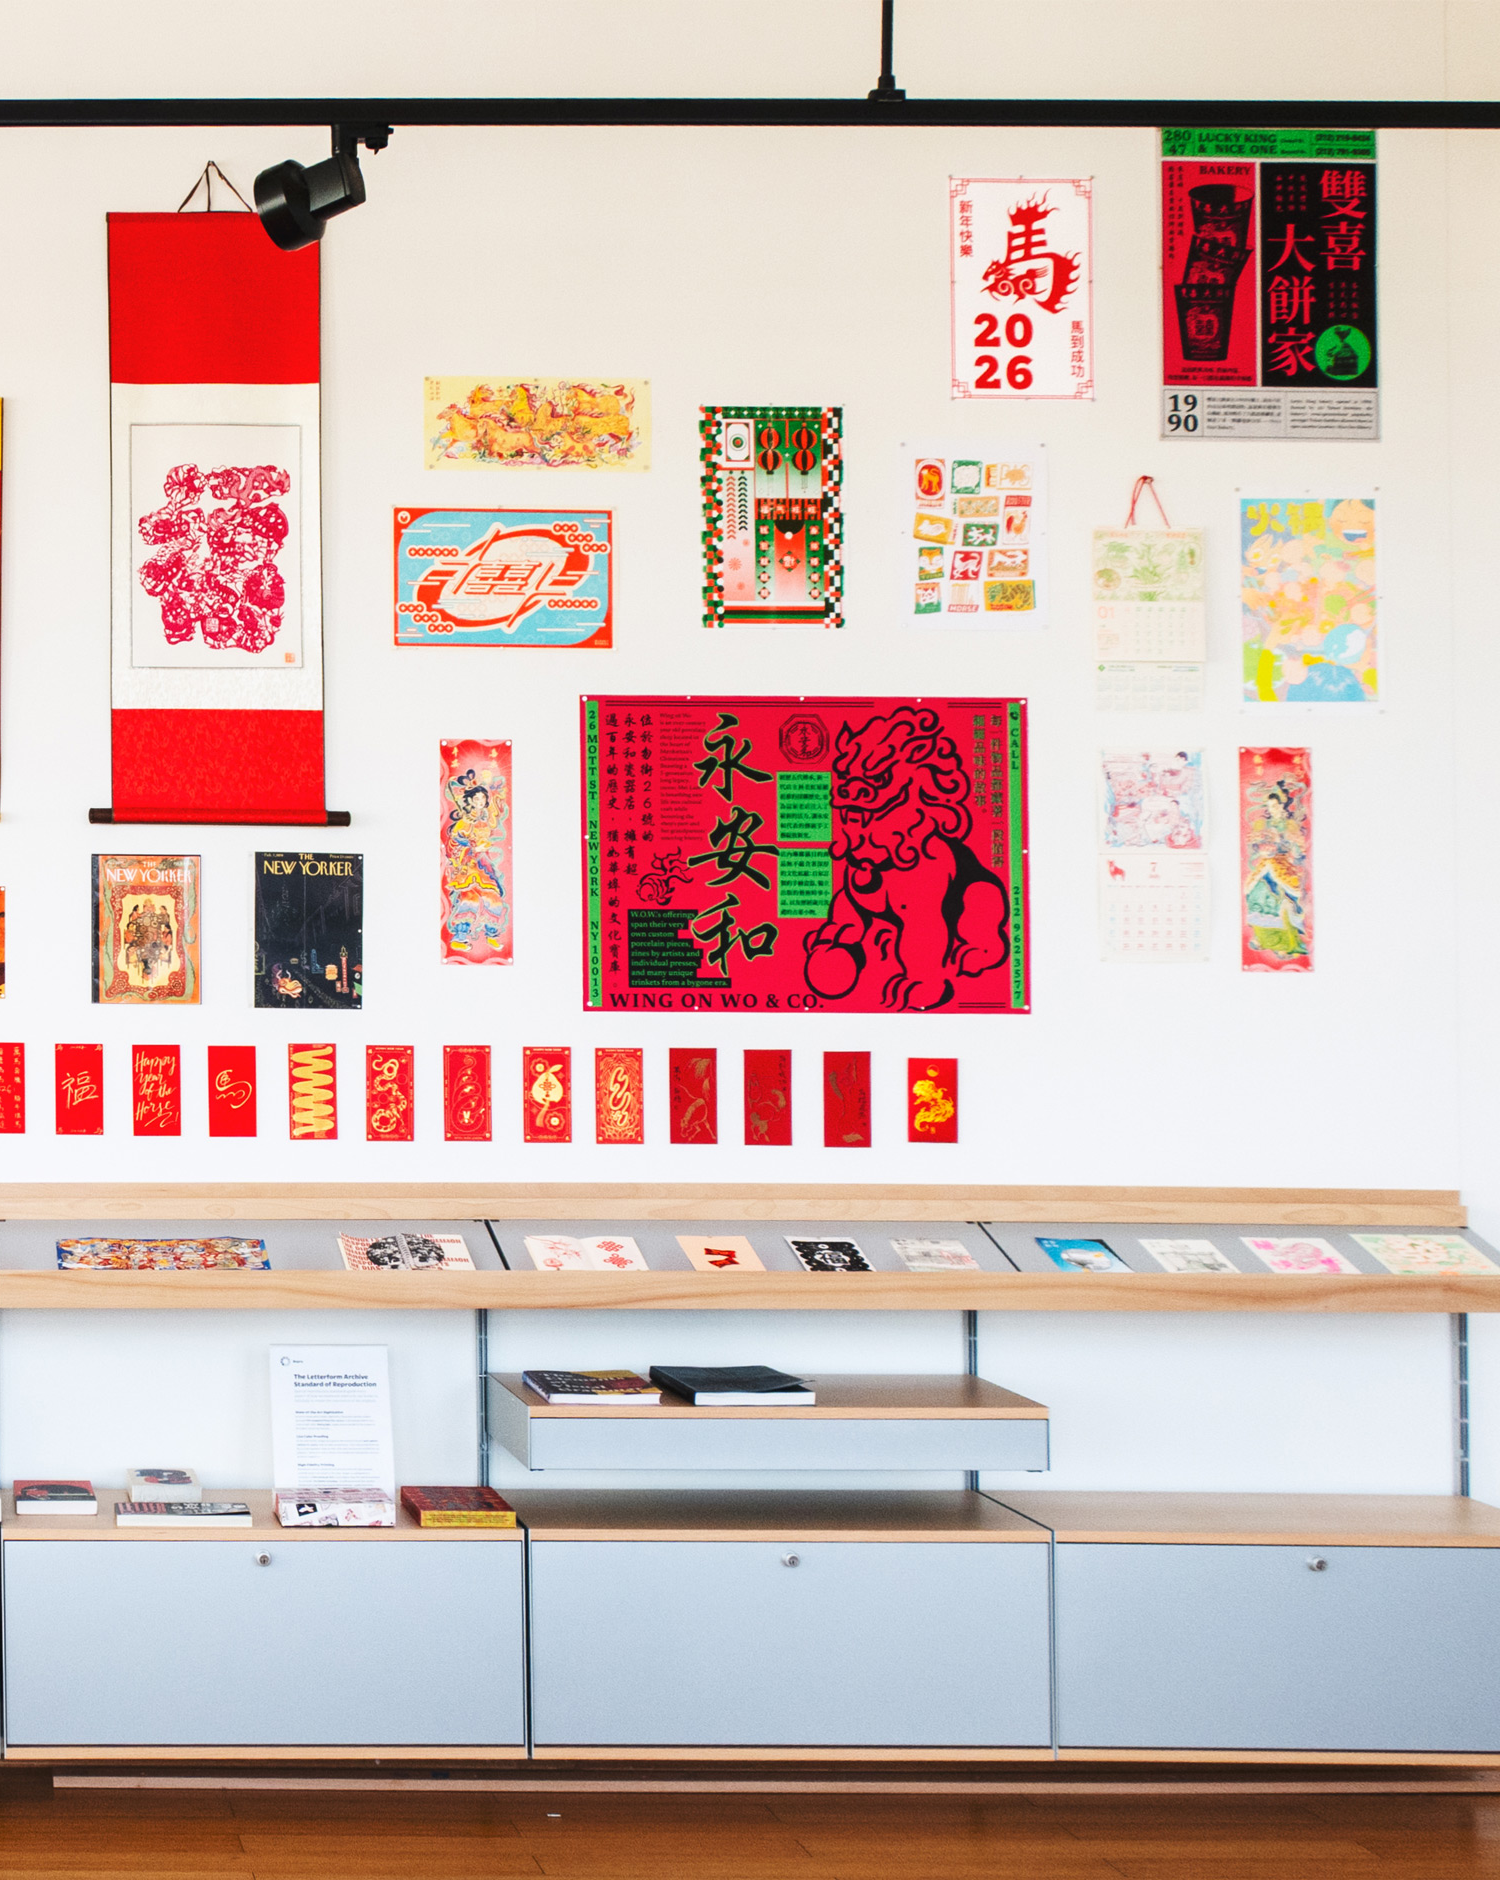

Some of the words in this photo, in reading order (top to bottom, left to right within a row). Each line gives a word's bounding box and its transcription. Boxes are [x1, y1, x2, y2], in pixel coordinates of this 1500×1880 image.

[1164, 130, 1191, 142] 280
[1198, 133, 1240, 143] LUCKY
[1244, 133, 1277, 144] KING
[1170, 144, 1187, 155] 47
[1215, 145, 1245, 154] NICE
[1250, 145, 1277, 154] ONE
[1199, 166, 1251, 175] BAKERY
[959, 200, 974, 258] 新年快樂
[1319, 169, 1368, 271] 雙喜
[1267, 223, 1316, 377] 大餅家
[1070, 320, 1085, 379] 馬到成功
[588, 711, 596, 731] 26
[587, 735, 598, 776] MOTT
[1010, 728, 1019, 770] CALL
[298, 853, 315, 861] THE
[106, 868, 138, 883] NEW
[139, 868, 192, 883] YORKER
[263, 860, 297, 875] NEW
[298, 861, 354, 877] YORKER
[1013, 886, 1021, 917] 212
[662, 911, 695, 919] offerings
[591, 921, 600, 941] NY
[1013, 923, 1021, 954] 962
[630, 940, 665, 948] porcelain
[651, 949, 660, 958] by
[591, 944, 599, 998] 10013
[647, 970, 667, 978] many
[668, 970, 694, 978] unique
[1014, 958, 1022, 1000] 3577
[686, 979, 713, 988] bygone
[610, 993, 673, 1008] WING
[681, 993, 712, 1008] ON
[720, 993, 758, 1008] WO
[766, 993, 781, 1008] &
[787, 993, 824, 1009] CO.
[134, 1050, 176, 1076] Happy
[61, 1070, 100, 1110] 福
